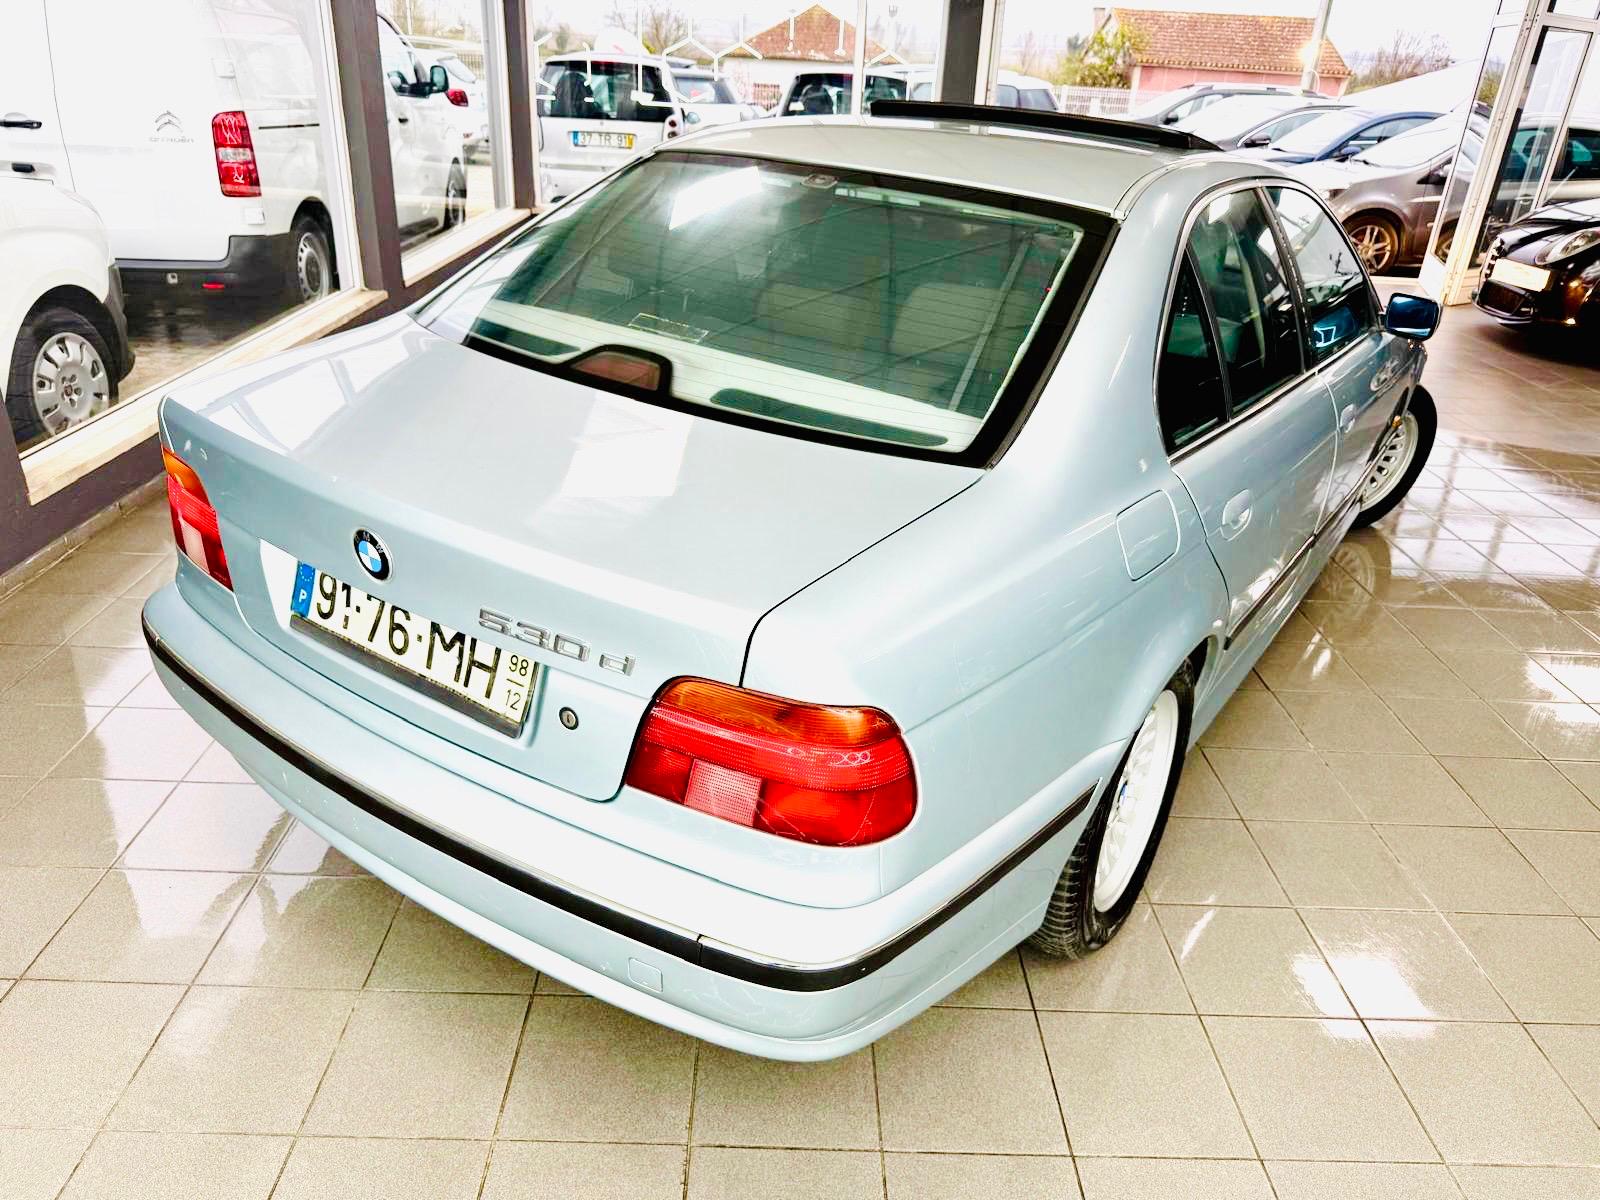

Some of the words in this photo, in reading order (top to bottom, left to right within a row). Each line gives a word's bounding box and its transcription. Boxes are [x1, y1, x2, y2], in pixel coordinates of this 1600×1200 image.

[299, 589, 307, 602] P
[478, 606, 591, 662] 530
[600, 654, 636, 677] d
[508, 654, 529, 677] 98
[505, 689, 521, 711] 12
